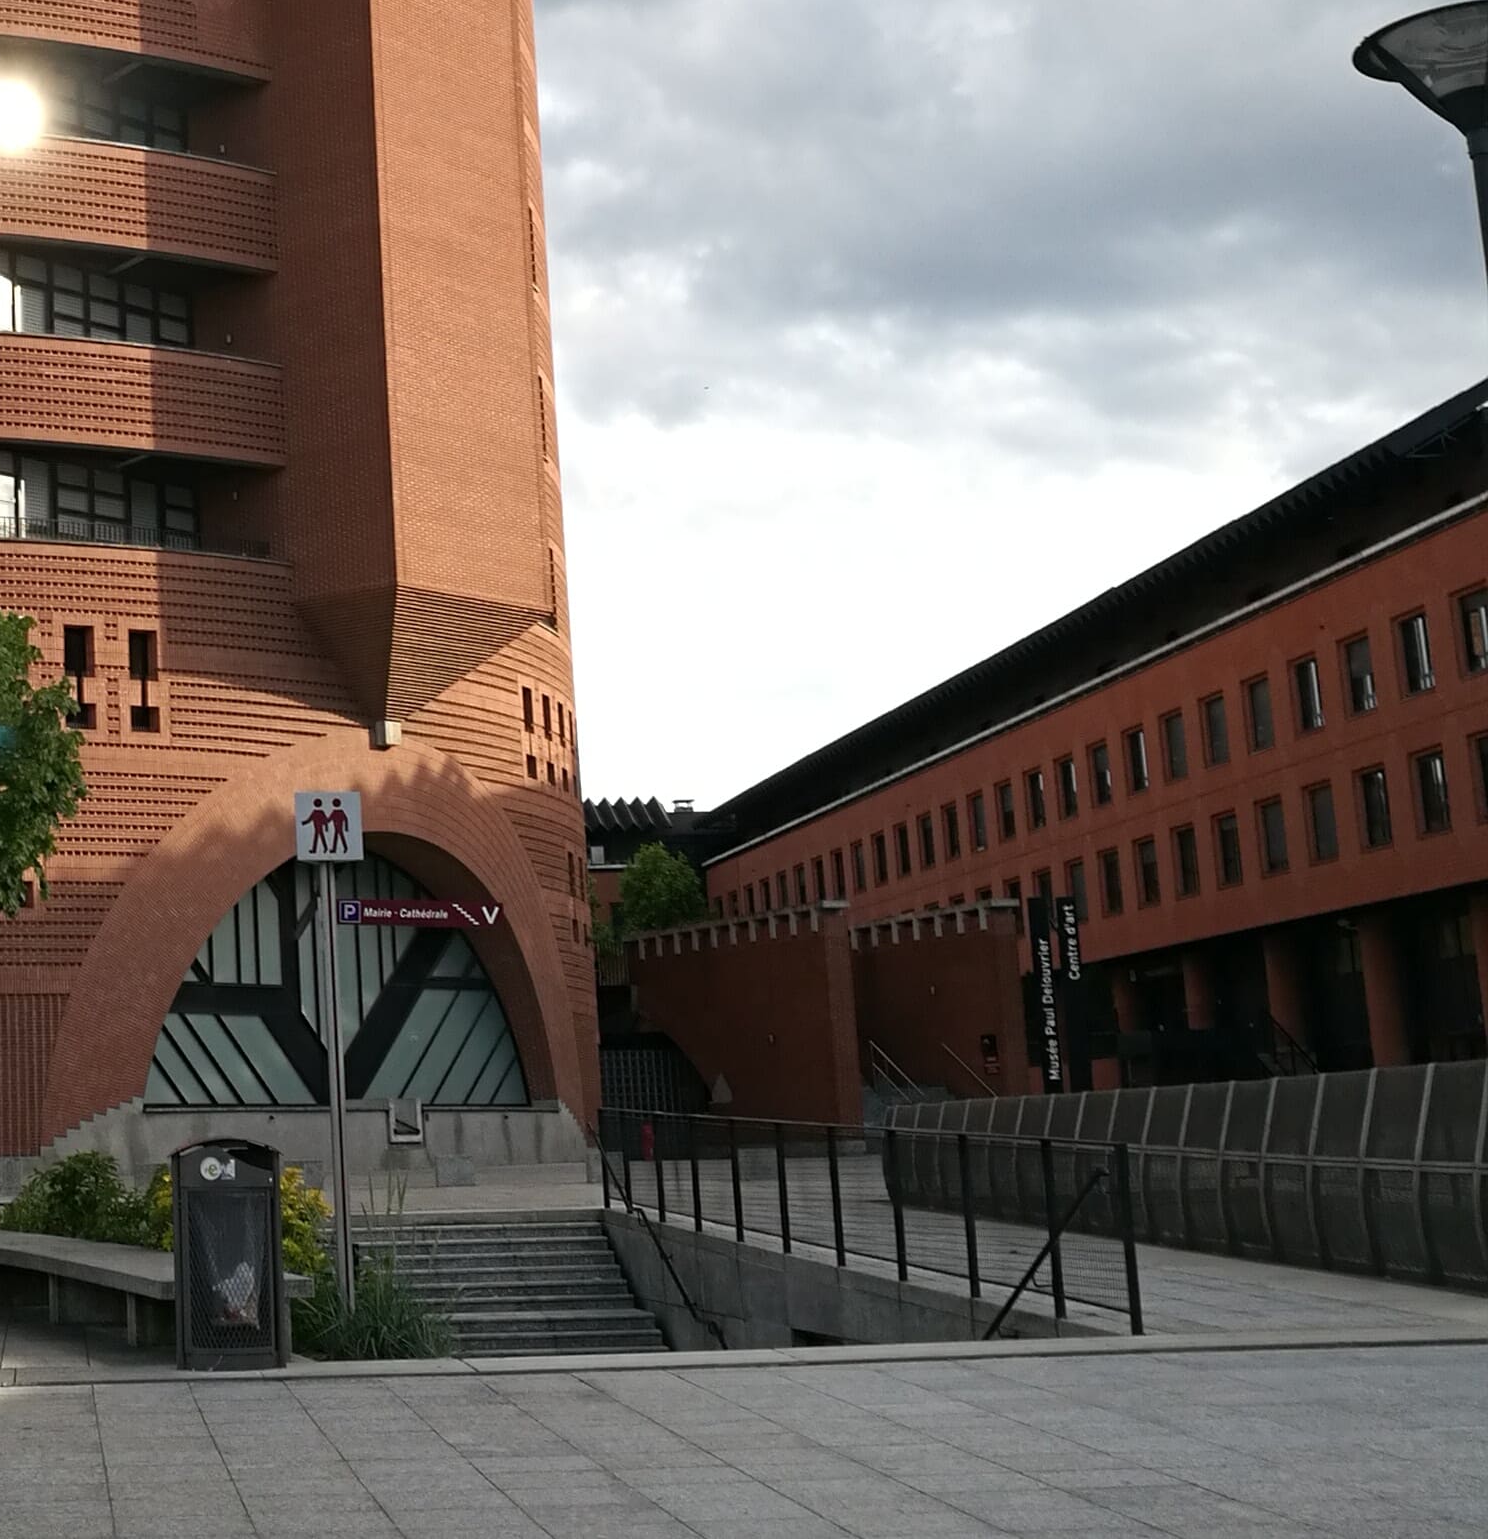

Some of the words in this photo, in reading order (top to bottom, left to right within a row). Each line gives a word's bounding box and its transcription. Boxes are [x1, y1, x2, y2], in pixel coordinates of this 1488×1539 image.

[344, 904, 356, 919] P
[363, 906, 392, 918] Mairie
[399, 907, 448, 919] Cathédrale
[1063, 903, 1077, 935] d'art
[1038, 938, 1054, 1005] Delouvrier
[1067, 937, 1080, 981] Centre
[1044, 1007, 1057, 1036] Paul
[1047, 1038, 1061, 1080] Musée
